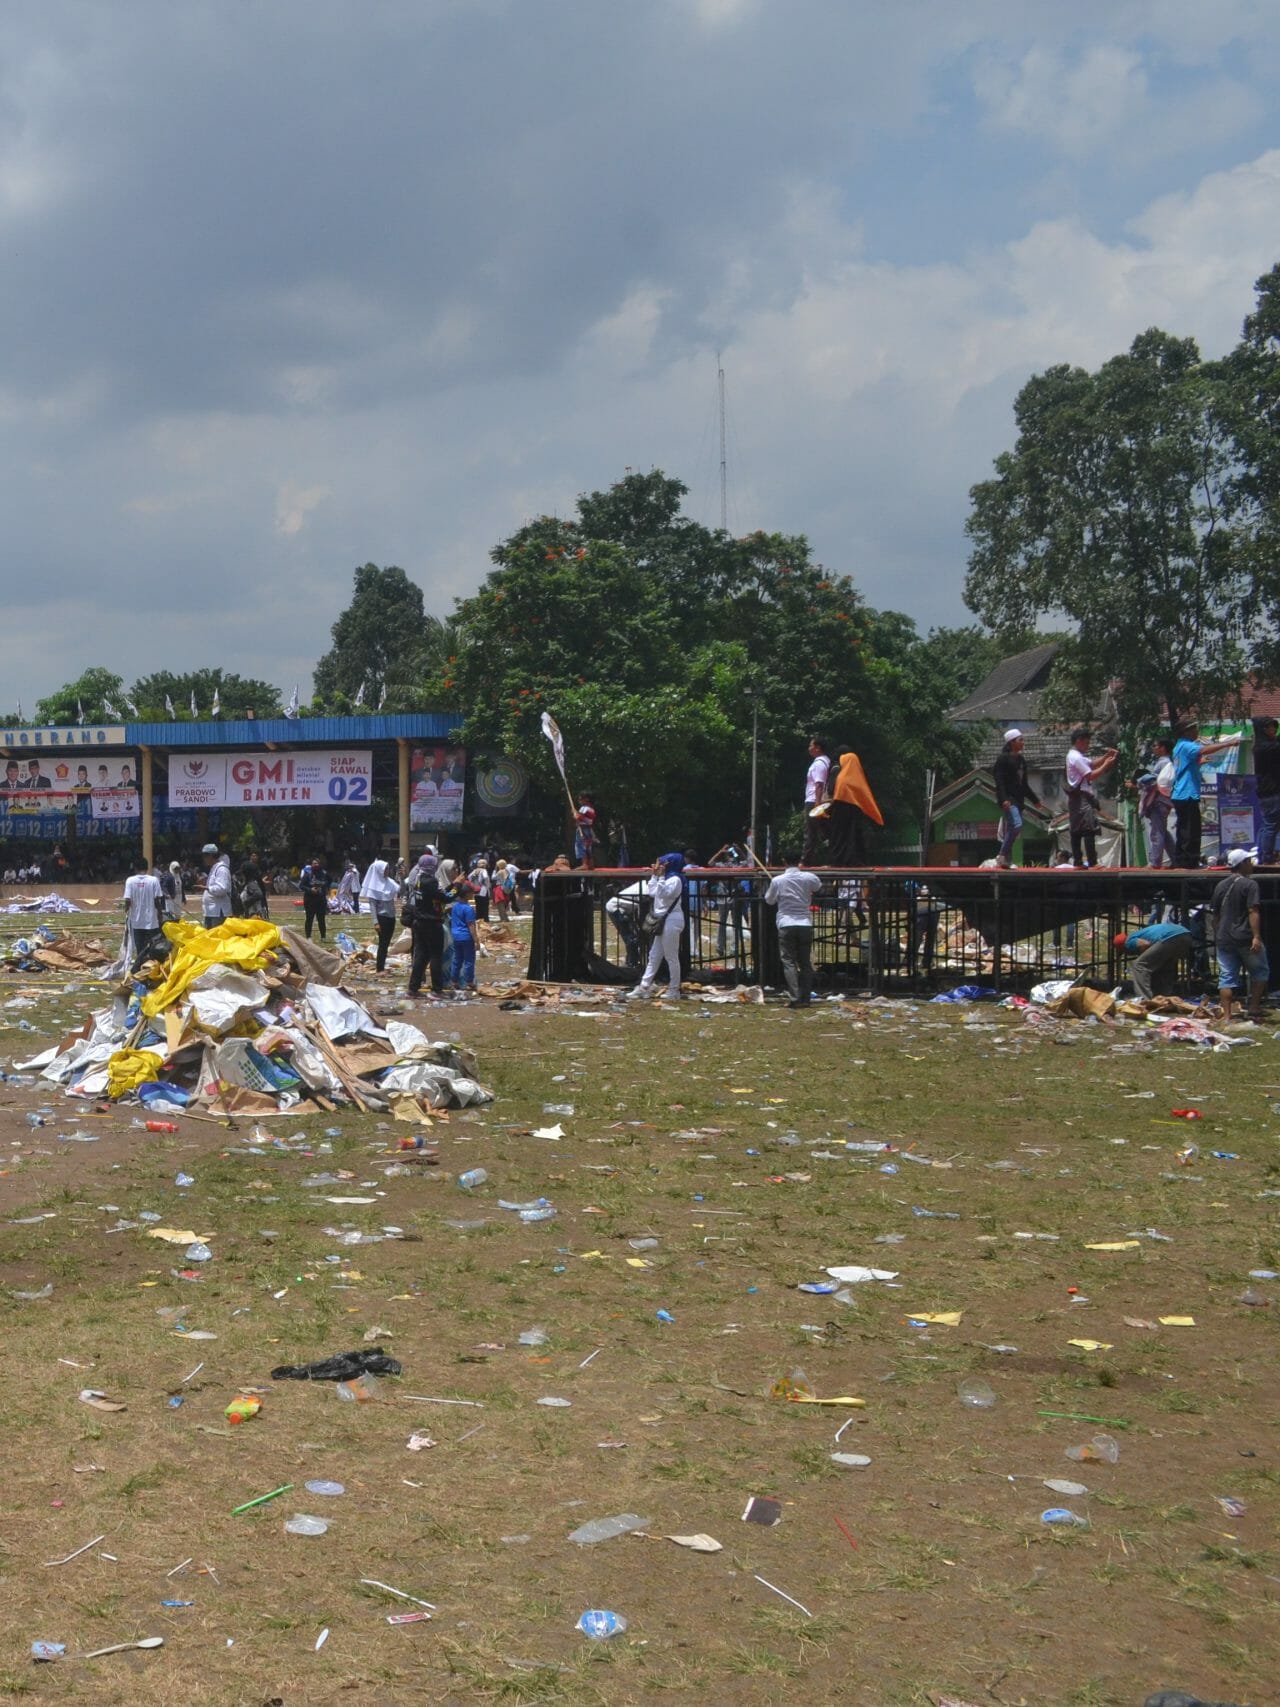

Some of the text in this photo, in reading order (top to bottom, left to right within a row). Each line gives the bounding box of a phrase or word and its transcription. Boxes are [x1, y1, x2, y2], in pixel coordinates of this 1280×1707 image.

[330, 757, 356, 766] SIAP
[232, 759, 294, 785] GMI
[330, 765, 369, 775] KAWAL
[175, 788, 216, 796] PRABOWO
[243, 787, 311, 801] BANTEN
[328, 776, 368, 801] 02
[0, 820, 14, 835] 12
[28, 820, 41, 836] 12
[85, 819, 100, 835] 12
[114, 818, 129, 835] 12
